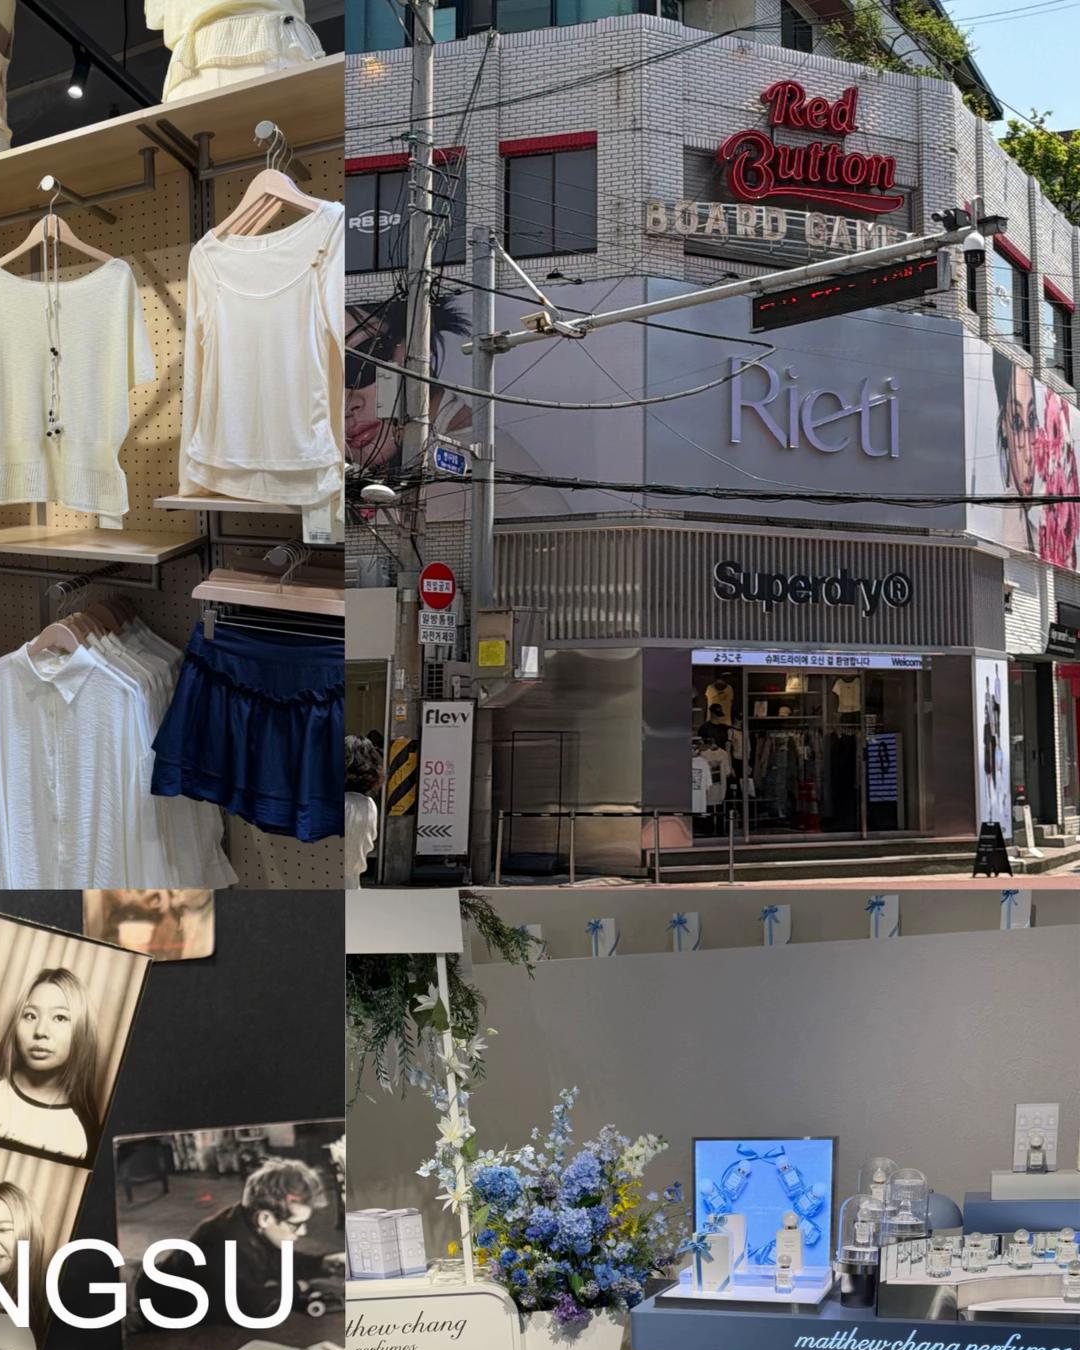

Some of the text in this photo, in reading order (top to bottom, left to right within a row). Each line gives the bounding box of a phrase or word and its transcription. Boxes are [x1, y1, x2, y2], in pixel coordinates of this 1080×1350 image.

[760, 79, 858, 134] Red
[716, 129, 904, 214] Button
[646, 200, 788, 242] BOARD
[731, 357, 901, 459] Rieti
[426, 581, 451, 592] 진입금지
[422, 613, 454, 626] 일방통행
[713, 653, 742, 663] ようこそ
[765, 654, 808, 665] 슈퍼드라이에
[810, 656, 824, 665] 오신
[836, 656, 870, 667] 환영합니다
[424, 778, 456, 791] SALE
[422, 800, 455, 815] SALE
[401, 1310, 467, 1340] chang
[794, 1327, 891, 1350] matthew
